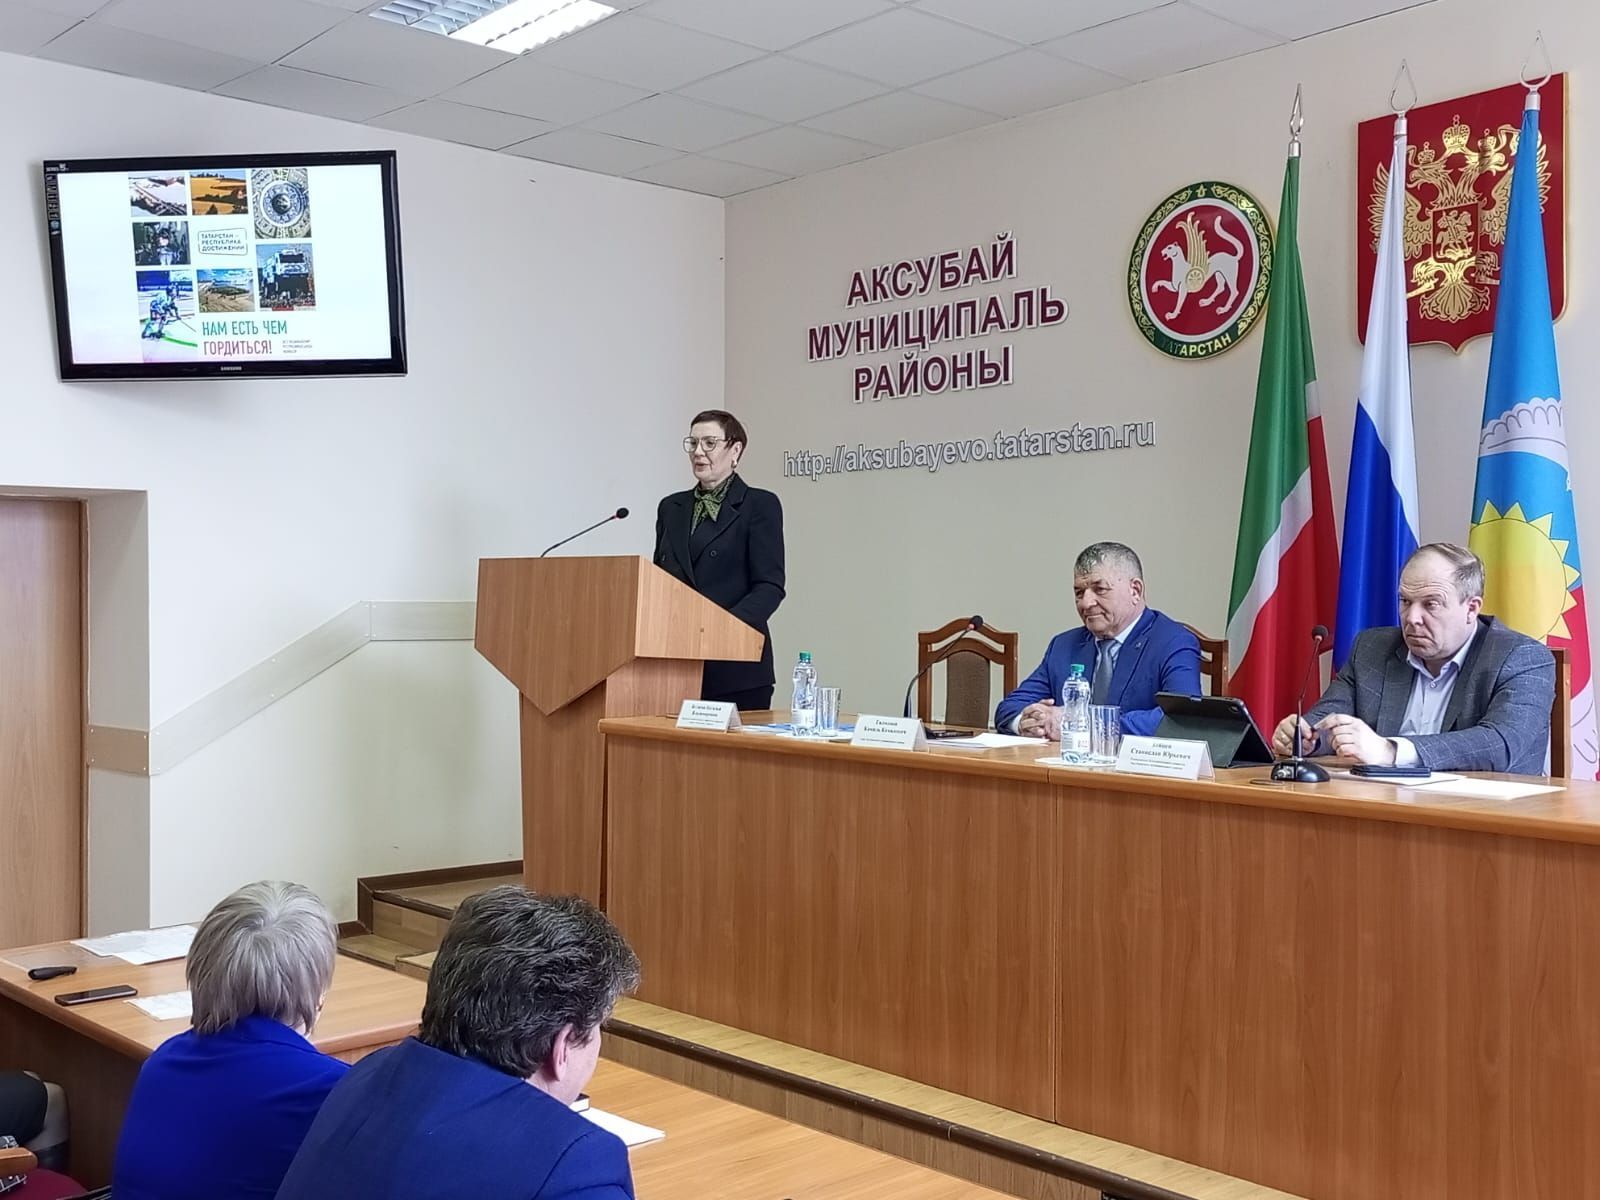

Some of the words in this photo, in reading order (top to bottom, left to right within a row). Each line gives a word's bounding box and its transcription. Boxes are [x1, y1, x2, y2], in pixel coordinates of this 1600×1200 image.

[846, 231, 1018, 308] АКСУБАЙ
[202, 321, 228, 336] НАМ
[231, 320, 259, 335] ЕСТЬ
[262, 319, 288, 335] ЧЕМ
[203, 339, 273, 357] ГОРДИТЬСЯ!
[807, 285, 1069, 361] МУНИЦИПАЛЬ
[853, 345, 1014, 403] РАЙОНЫ
[783, 420, 1157, 481] http://aksubayevo.tatarstan.ru
